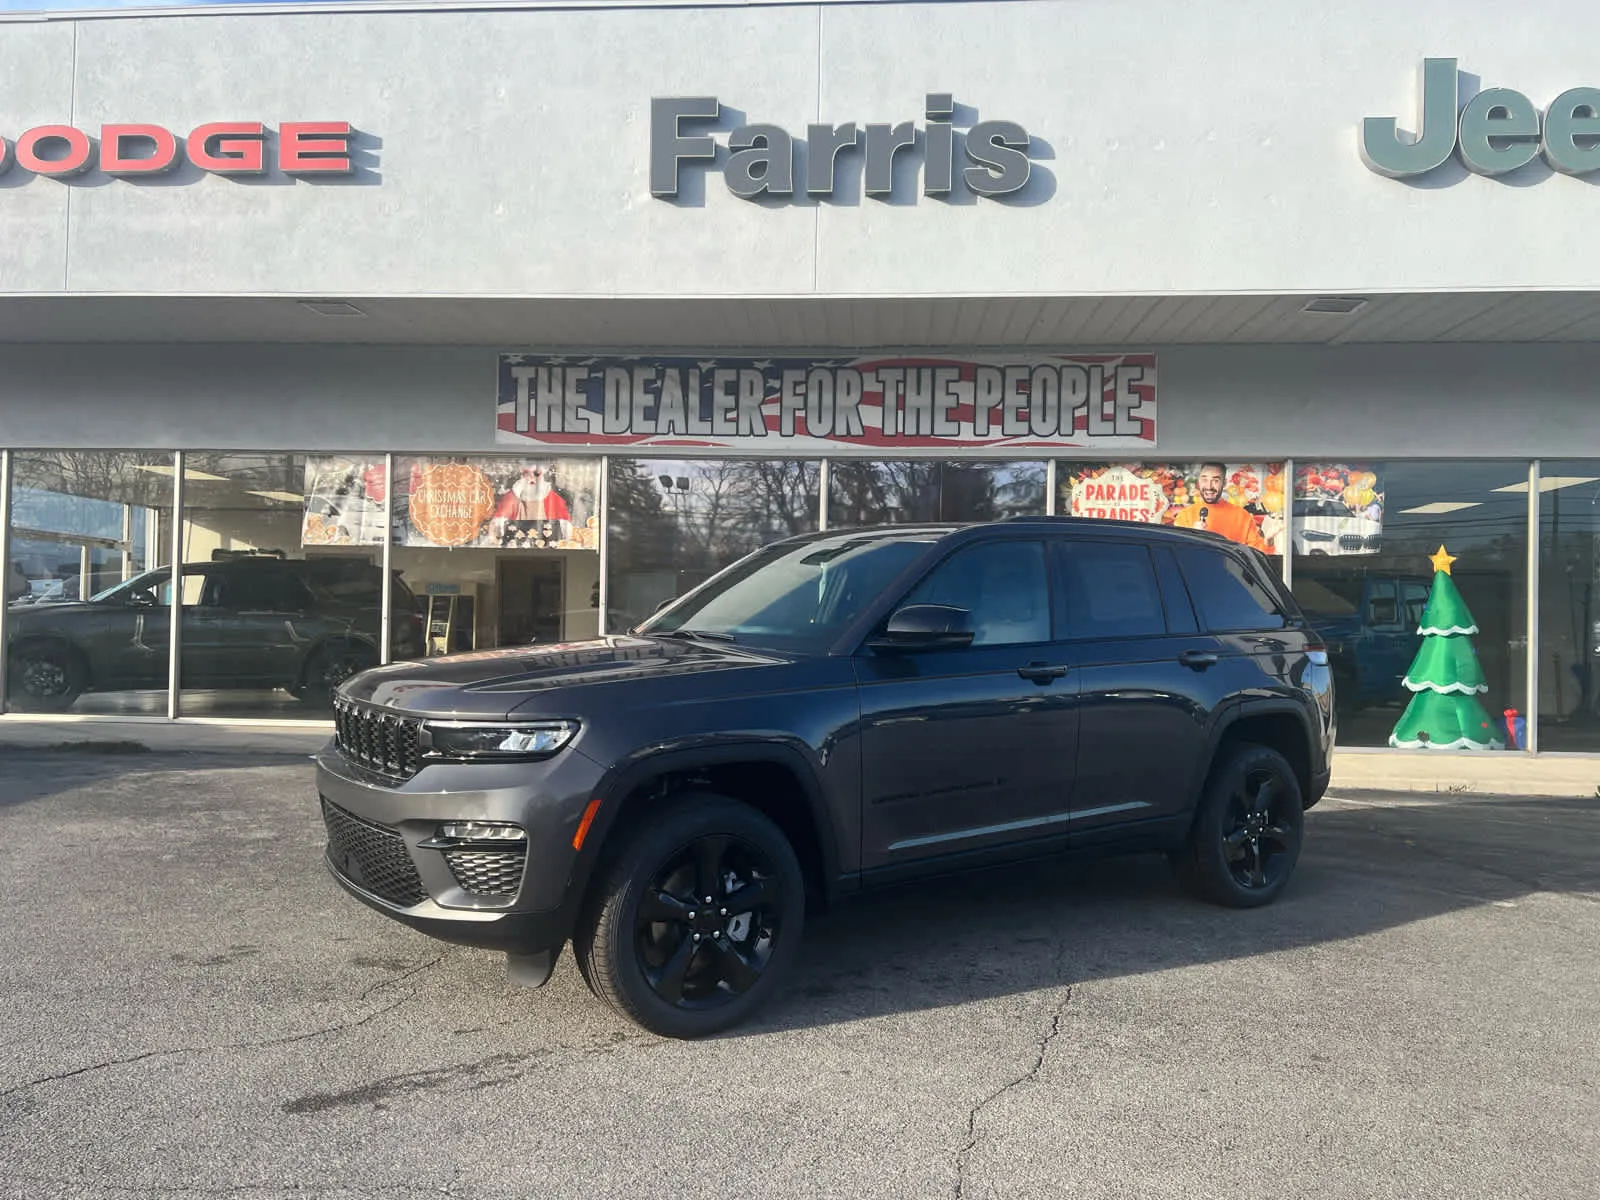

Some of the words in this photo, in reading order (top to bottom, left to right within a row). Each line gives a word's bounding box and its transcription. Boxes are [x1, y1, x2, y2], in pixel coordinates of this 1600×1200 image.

[0, 121, 350, 174] ODGE
[651, 93, 1031, 196] Farris
[509, 364, 590, 433] THE
[602, 365, 769, 437] DEALER
[779, 366, 866, 437] FOR
[876, 365, 961, 437] THE
[973, 364, 1145, 437] PEOPLE
[418, 488, 467, 504] CHRISTMAS
[1085, 484, 1150, 501] PARADE
[430, 504, 473, 519] EXCHANGE
